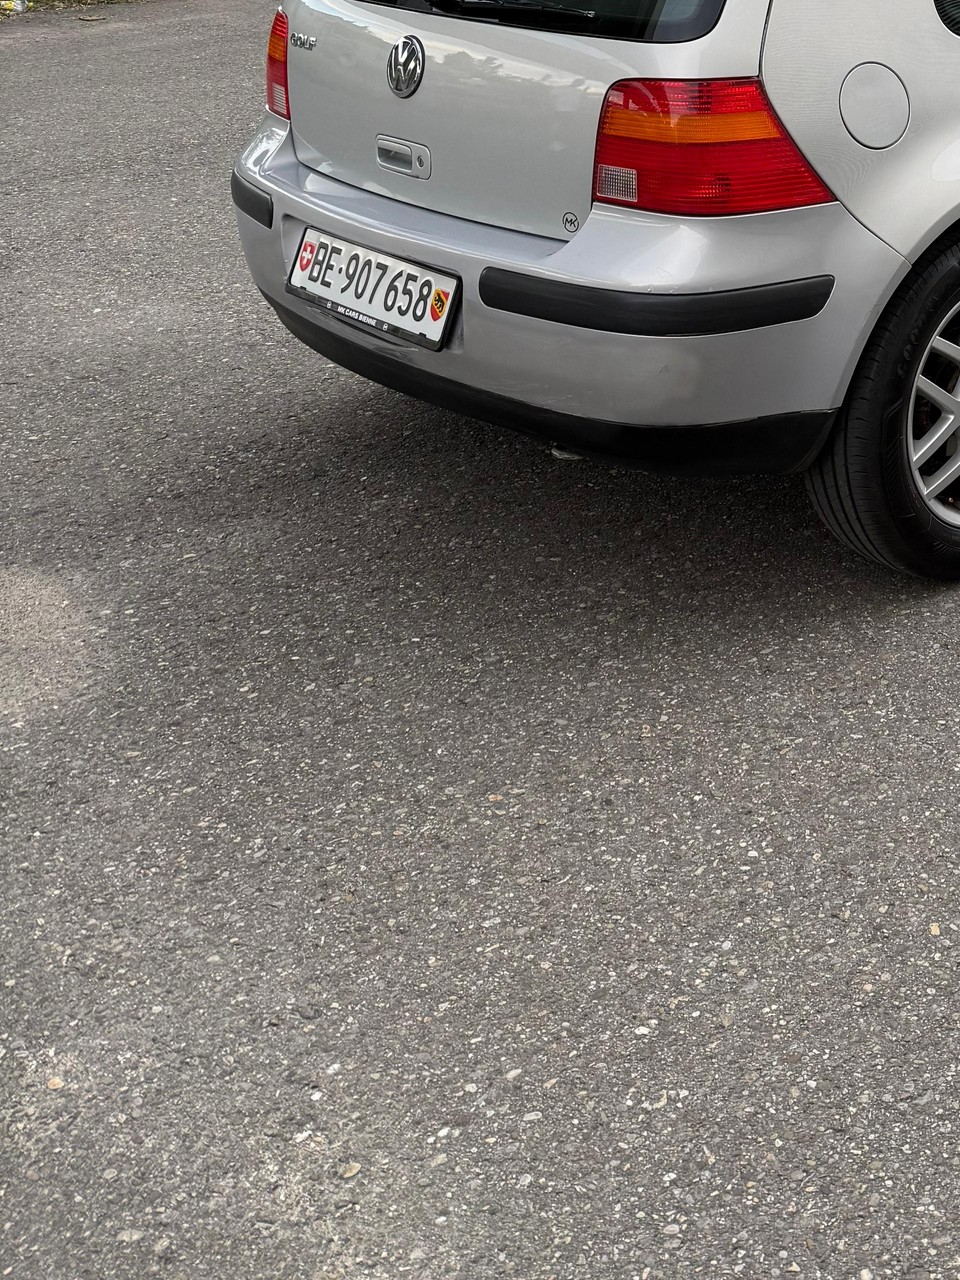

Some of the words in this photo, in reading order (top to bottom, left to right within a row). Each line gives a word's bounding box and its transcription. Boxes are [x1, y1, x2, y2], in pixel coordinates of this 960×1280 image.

[290, 31, 317, 51] GOLF
[337, 305, 345, 314] MK
[345, 309, 359, 320] CARS
[358, 314, 377, 326] BIENNE
